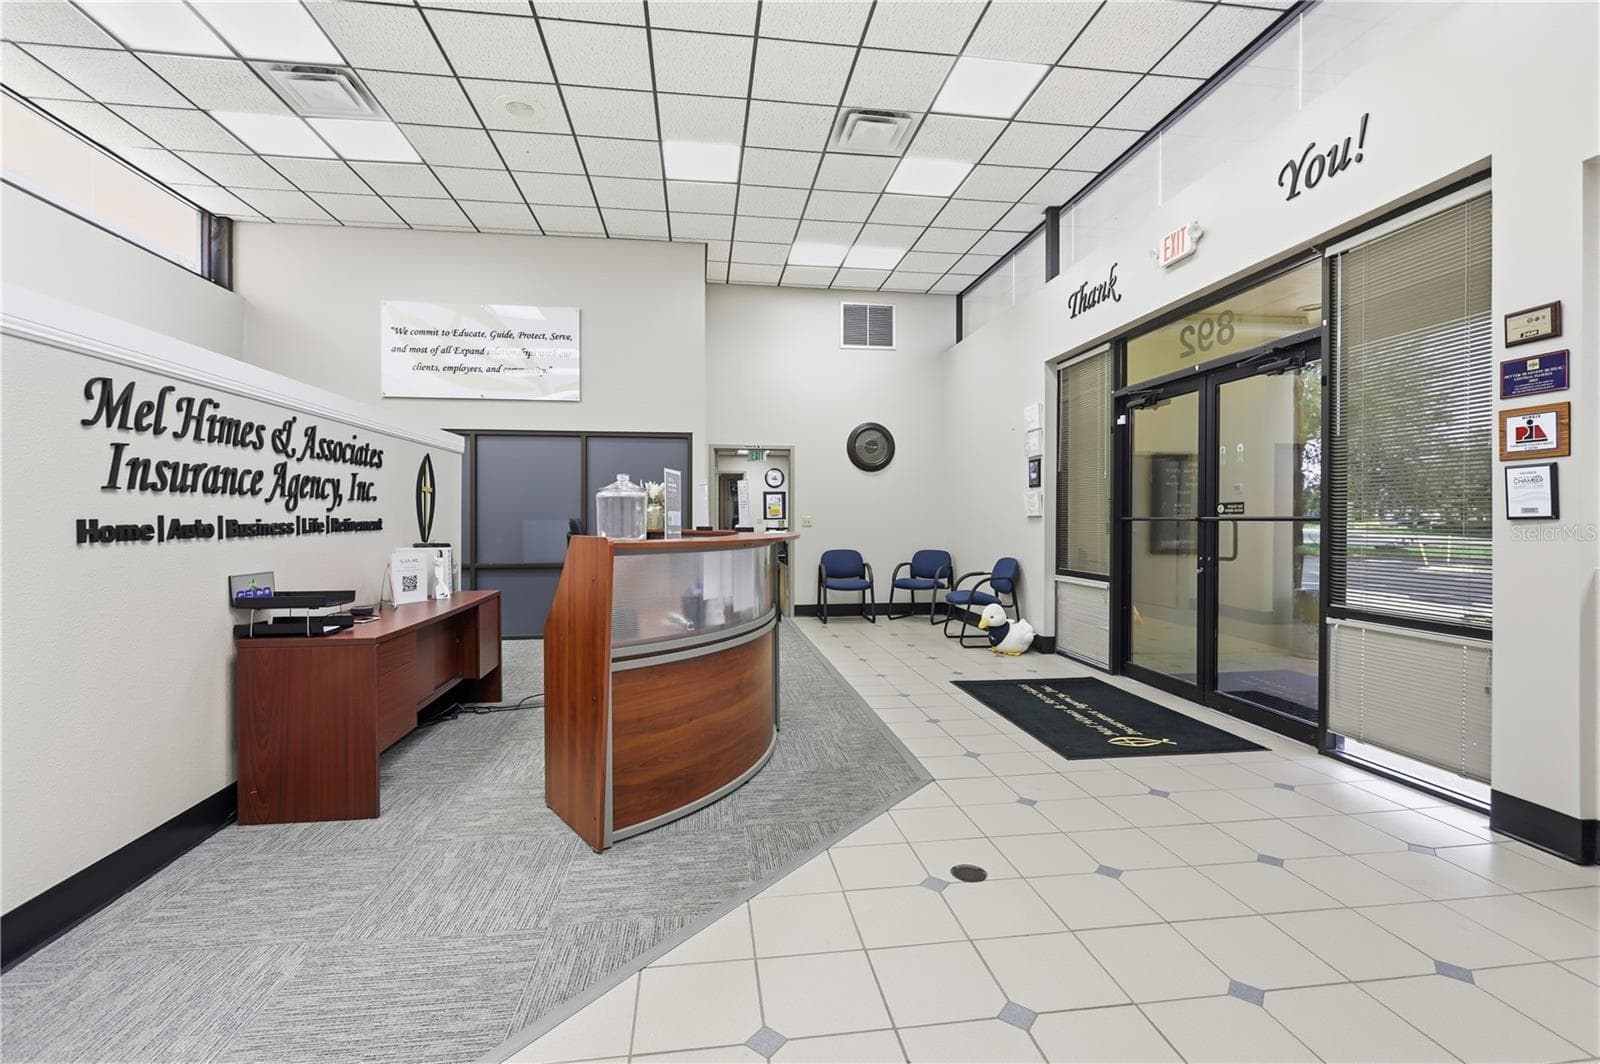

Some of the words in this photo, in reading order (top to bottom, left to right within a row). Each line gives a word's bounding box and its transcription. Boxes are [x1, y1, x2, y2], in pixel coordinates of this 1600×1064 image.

[1068, 262, 1122, 319] Thank
[1278, 112, 1370, 201] You!
[1162, 226, 1188, 262] EXIT
[410, 327, 439, 336] commit
[451, 328, 487, 339] Educate,
[489, 329, 515, 340] Guide,
[517, 331, 548, 341] Protect,
[549, 332, 573, 341] Serve,
[391, 344, 408, 353] and
[409, 346, 428, 354] most
[430, 345, 441, 356] of
[440, 345, 453, 354] all
[453, 346, 485, 357] Expand
[412, 362, 440, 372] clients,
[442, 363, 483, 374] employees,
[485, 364, 503, 373] and
[80, 376, 176, 436] Mel
[172, 396, 266, 451] Himes
[271, 416, 298, 459] &
[296, 424, 384, 469] Associates
[101, 442, 264, 497] Insurance
[264, 460, 343, 512] Agency,
[347, 472, 378, 503] Inc.
[76, 518, 155, 545] Home
[166, 518, 215, 541] Auto
[225, 518, 295, 539] Business
[301, 516, 325, 535] Life
[330, 517, 383, 533] Retirement
